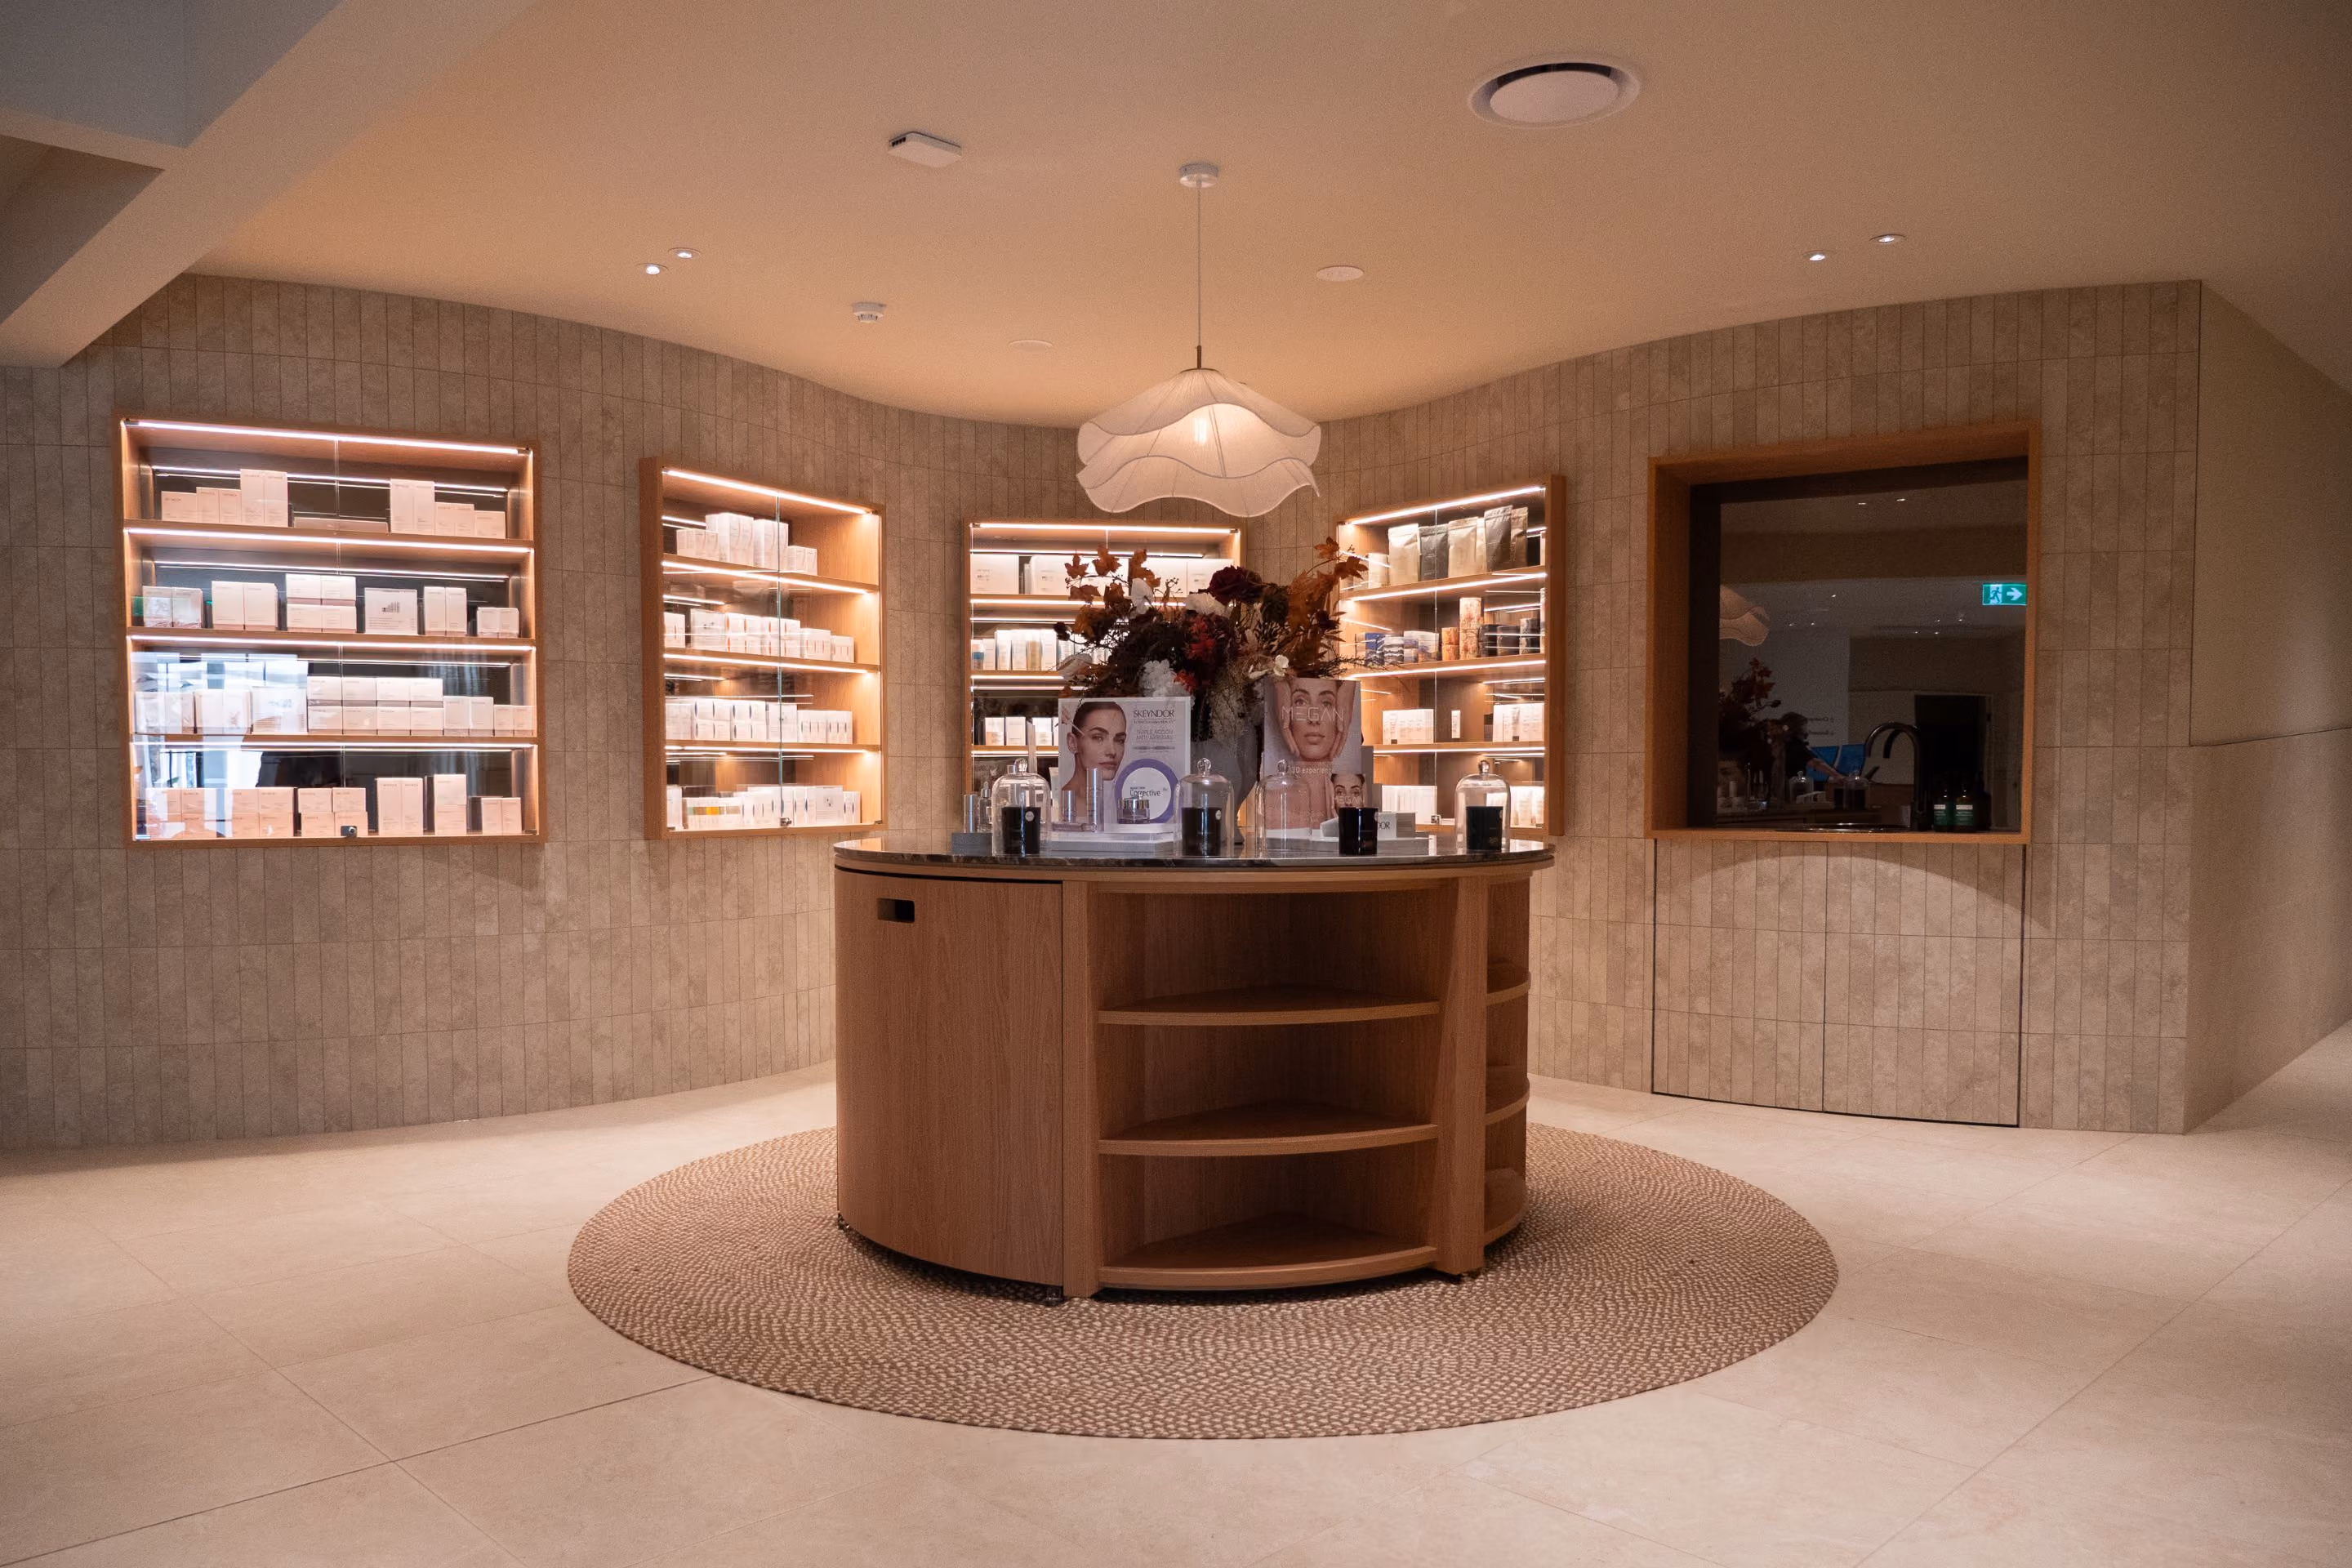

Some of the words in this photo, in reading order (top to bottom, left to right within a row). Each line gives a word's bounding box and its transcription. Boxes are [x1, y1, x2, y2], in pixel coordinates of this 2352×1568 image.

[1133, 709, 1175, 718] SKEYNDOR
[1281, 706, 1345, 722] MEGAN
[1129, 789, 1161, 797] Corrective
